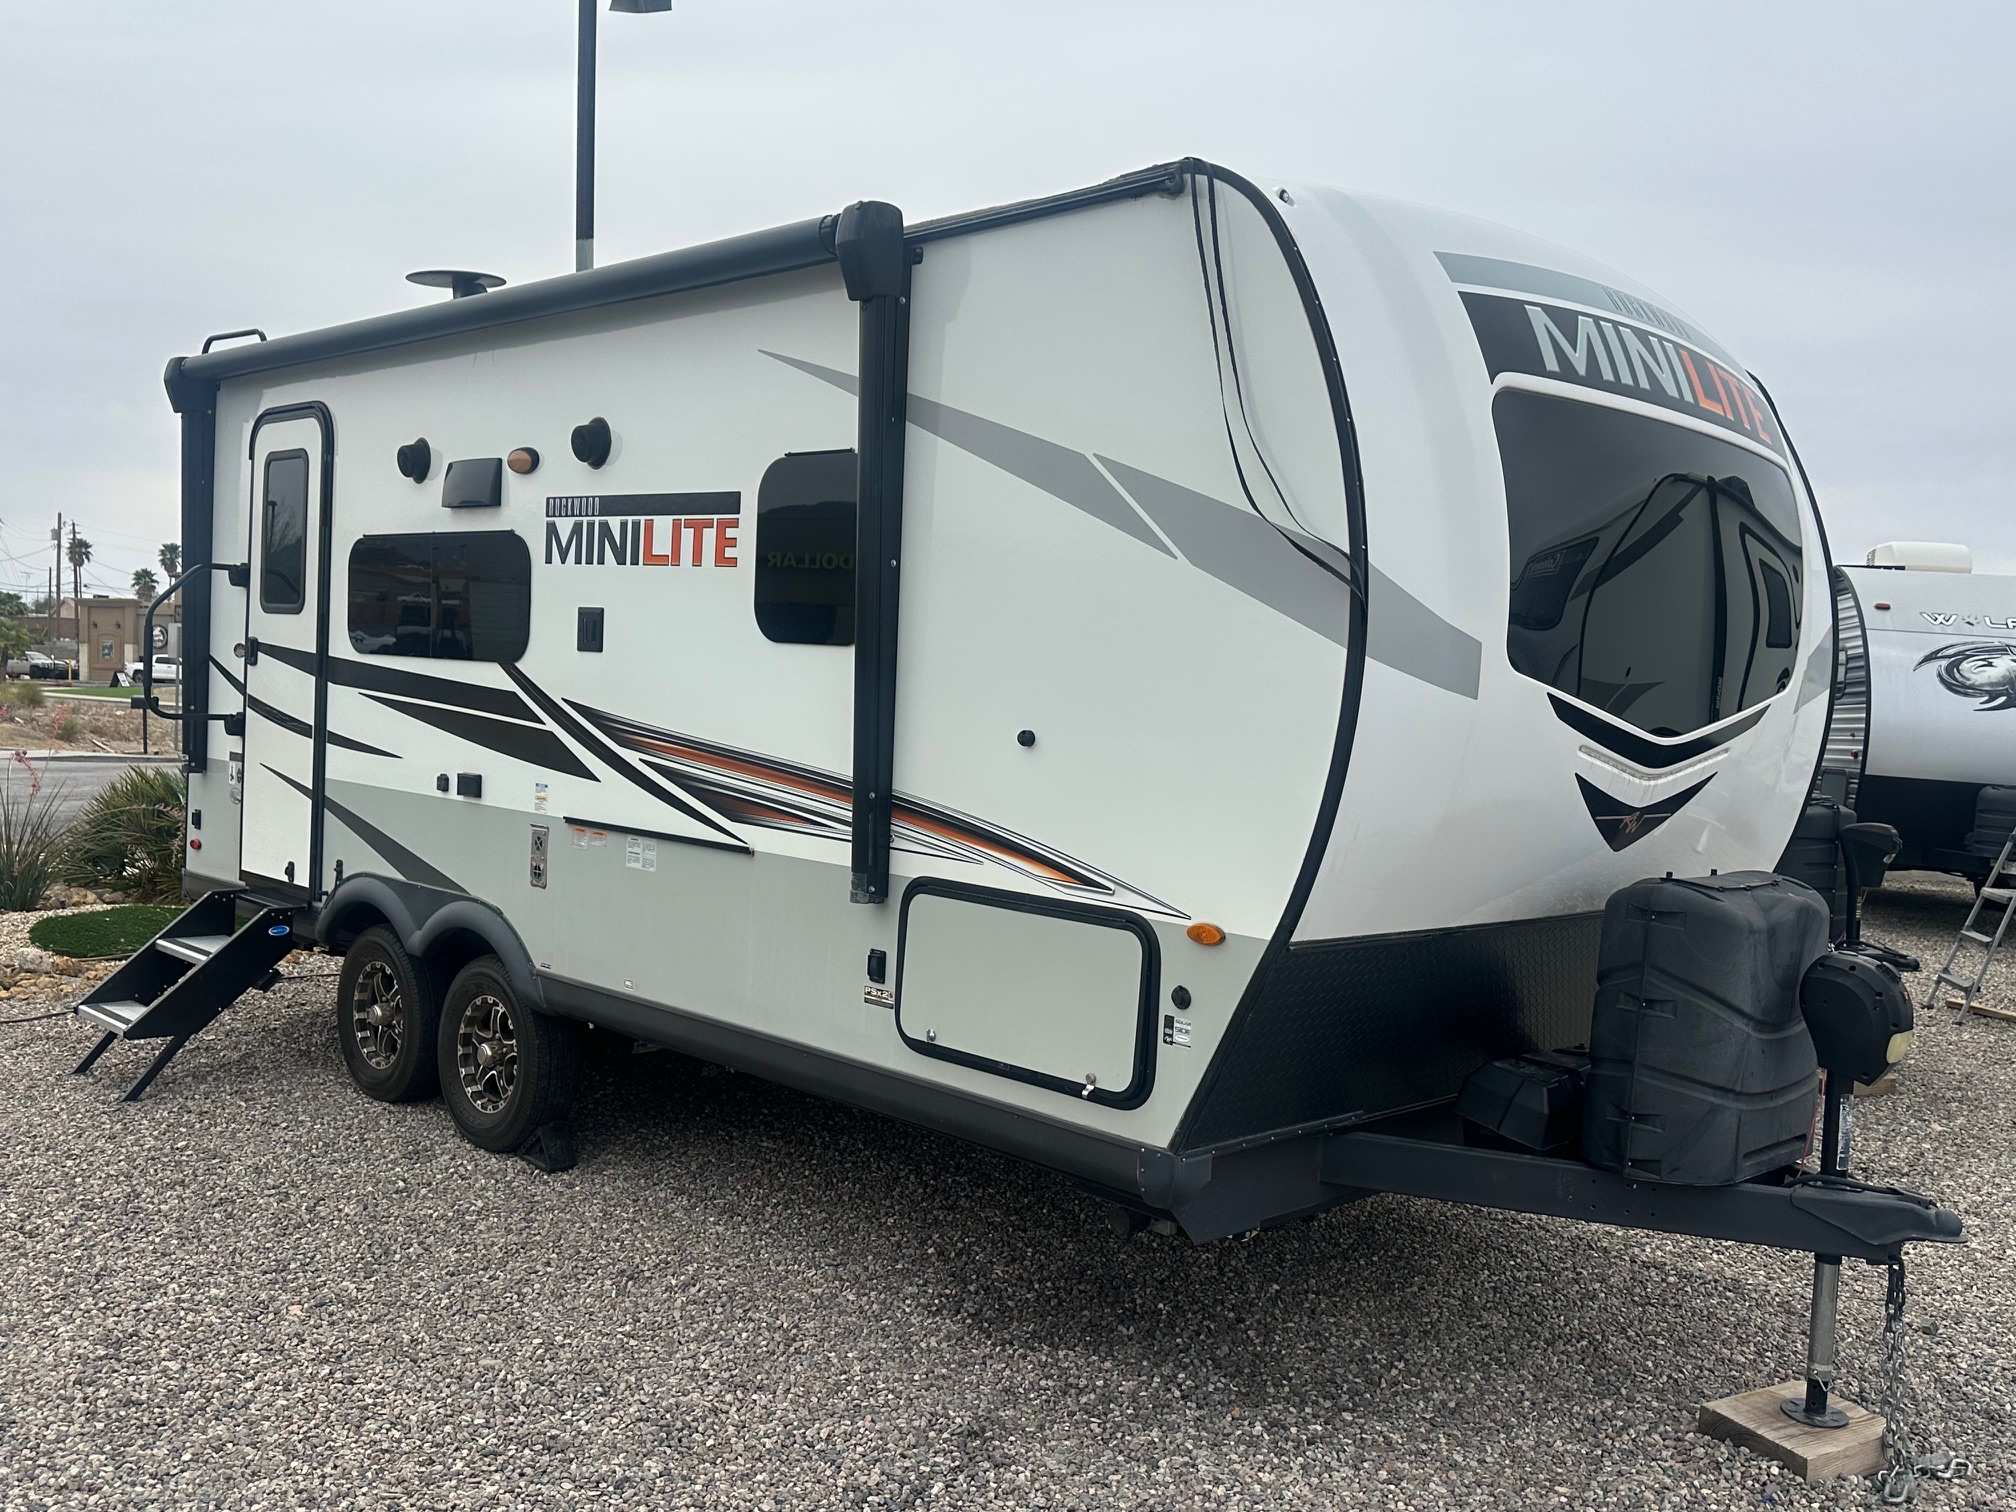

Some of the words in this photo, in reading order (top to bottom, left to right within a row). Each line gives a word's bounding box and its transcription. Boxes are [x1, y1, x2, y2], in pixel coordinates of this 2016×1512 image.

[1523, 304, 1773, 446] MINILITE
[548, 496, 600, 517] ROCKWOOD
[545, 517, 740, 568] MINILITE
